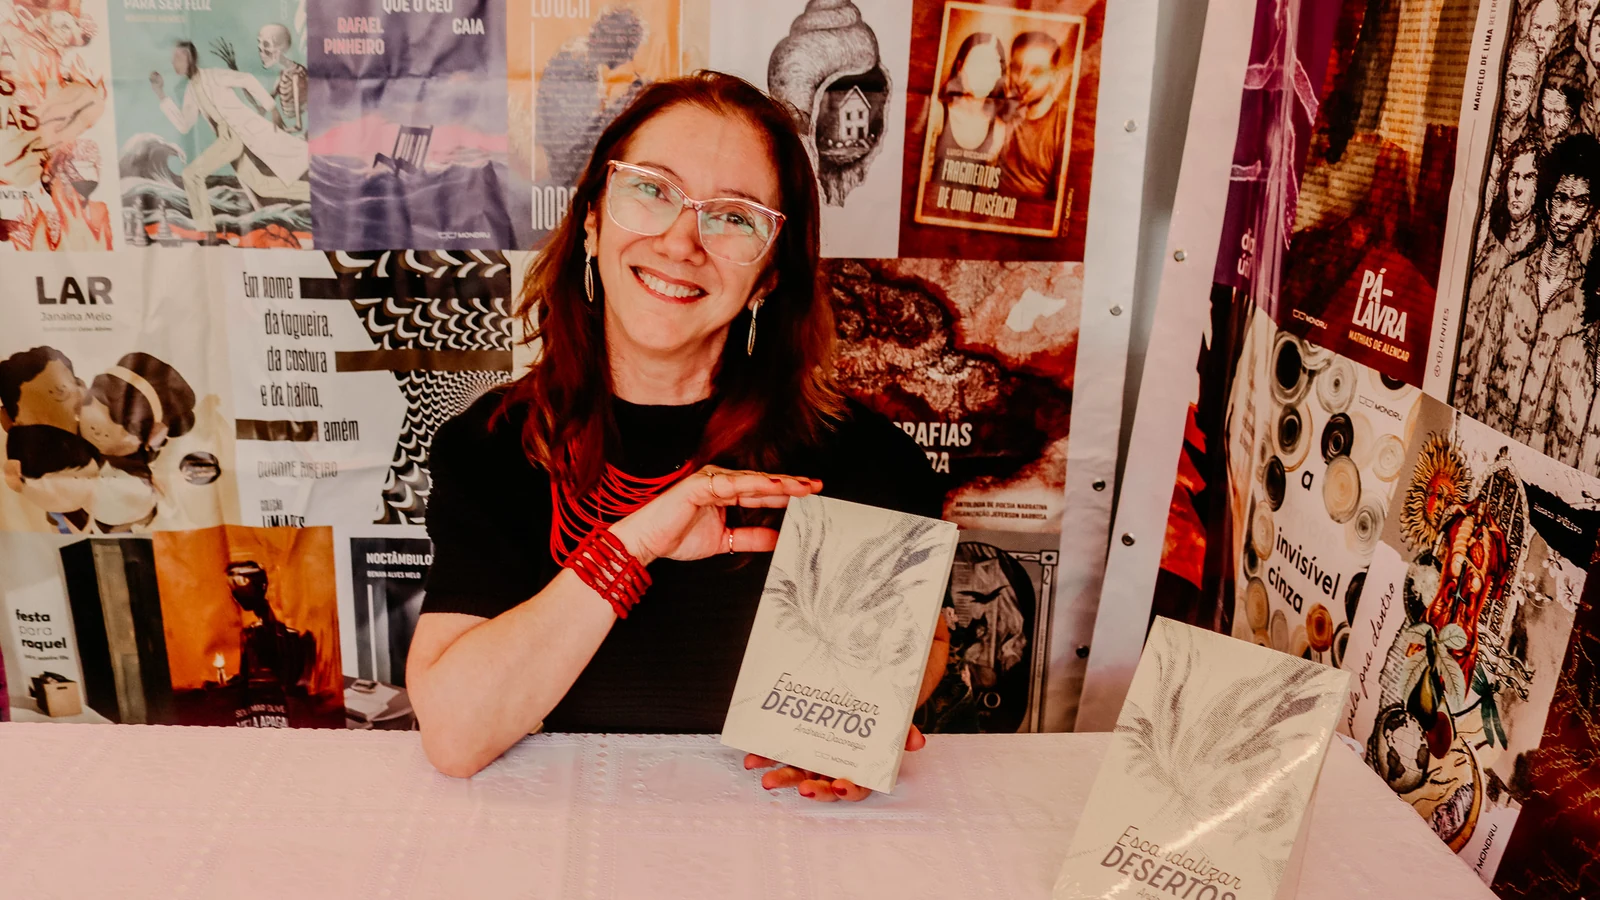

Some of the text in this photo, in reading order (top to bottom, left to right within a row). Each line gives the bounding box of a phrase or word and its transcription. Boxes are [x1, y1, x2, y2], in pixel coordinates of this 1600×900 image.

[337, 16, 384, 34] RAFAEL
[452, 18, 485, 35] CAIA
[324, 38, 385, 55] PINHEIRO
[1473, 28, 1494, 112] MARCELO DE LIMA
[941, 158, 1001, 189] FRAGMENTOS
[937, 185, 950, 209] DE
[950, 188, 973, 213] UMA
[35, 276, 113, 305] LAR
[243, 271, 294, 299] Em nome
[265, 309, 333, 340] da fogueira,
[1352, 296, 1407, 342] LAVRA
[1437, 308, 1450, 351] LENTES
[267, 346, 328, 373] da costura
[1348, 330, 1410, 363] MATHIAS DE ALENCAR
[260, 385, 267, 407] e
[286, 381, 323, 408] hálito,
[1374, 404, 1403, 421] MONDRU
[324, 418, 360, 442] amém
[892, 422, 973, 447] RAFIAS
[1301, 470, 1314, 491] a
[366, 551, 434, 566] NOCTÂMBULO
[1276, 527, 1341, 600] invisível
[1268, 567, 1304, 614] cinza
[16, 609, 51, 622] festa
[1370, 582, 1395, 647] dentro
[20, 625, 53, 637] para
[22, 637, 67, 651] raquel
[772, 672, 880, 716] Escandalizar
[761, 690, 877, 739] DESERTOS
[1116, 825, 1242, 890] Escadalizar
[1476, 823, 1499, 869] MONDRU
